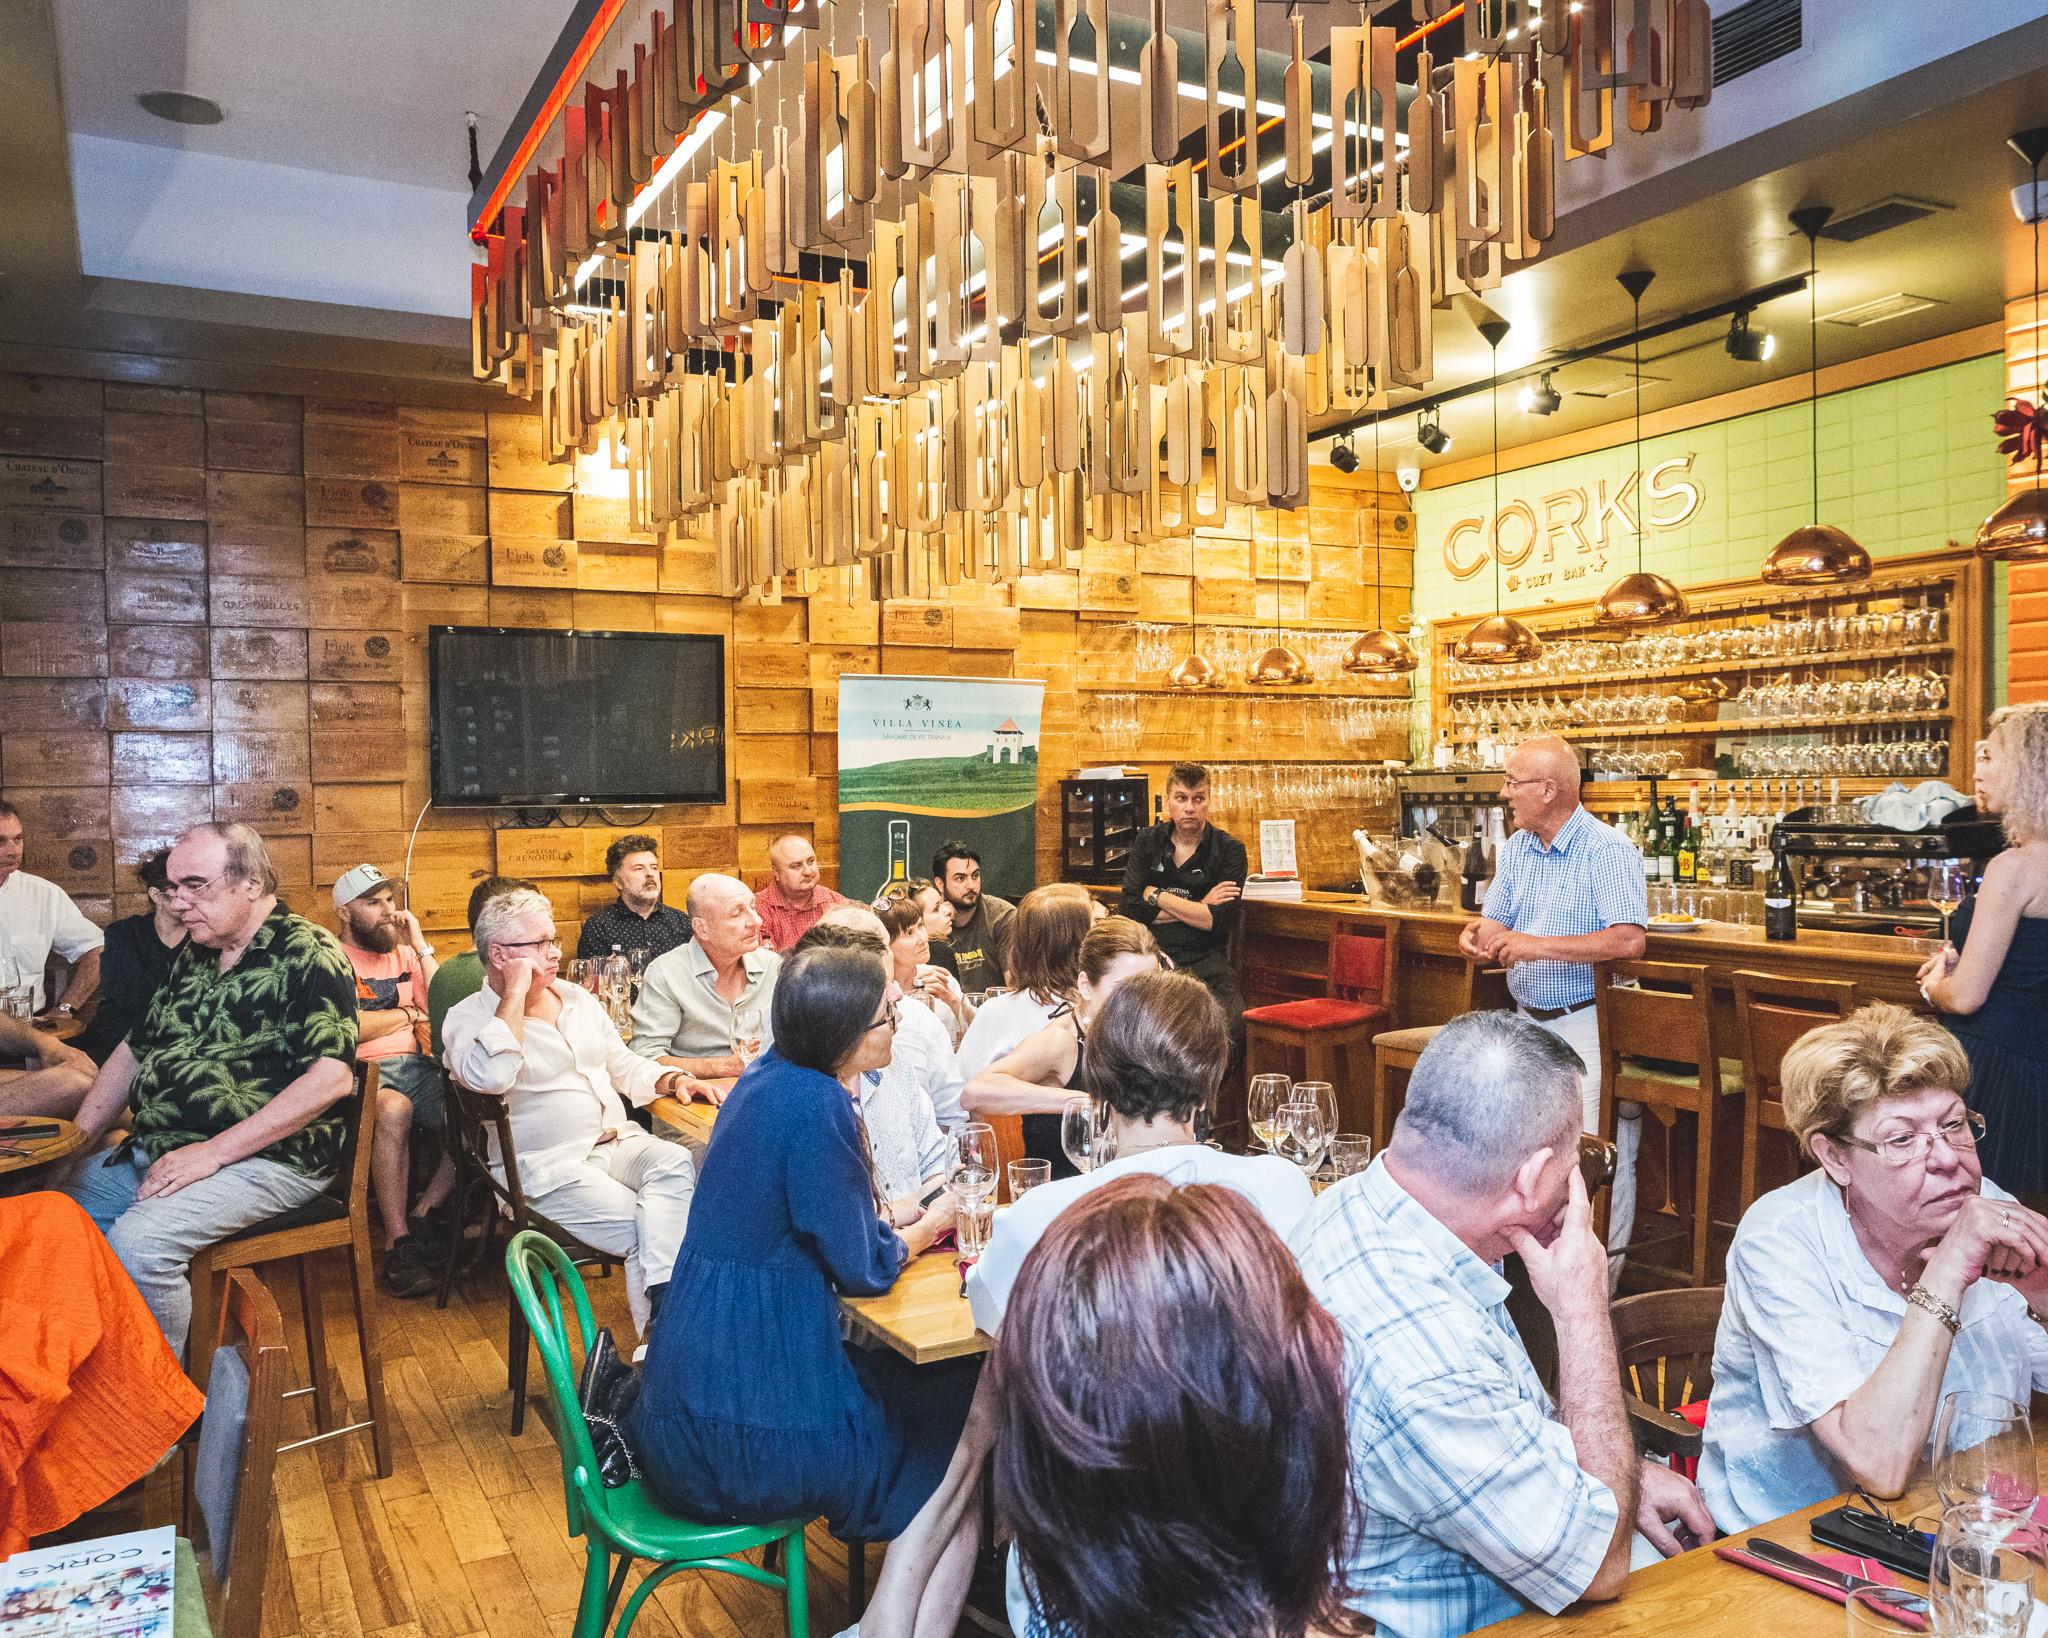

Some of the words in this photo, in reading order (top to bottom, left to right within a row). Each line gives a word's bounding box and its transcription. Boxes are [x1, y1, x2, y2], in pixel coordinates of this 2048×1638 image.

[1443, 452, 1704, 581] CORKS
[1526, 571, 1553, 589] COZY
[1563, 565, 1586, 582] BAR
[873, 718, 912, 728] VILLA
[921, 717, 962, 728] VINÉA
[18, 1548, 143, 1577] CORKS
